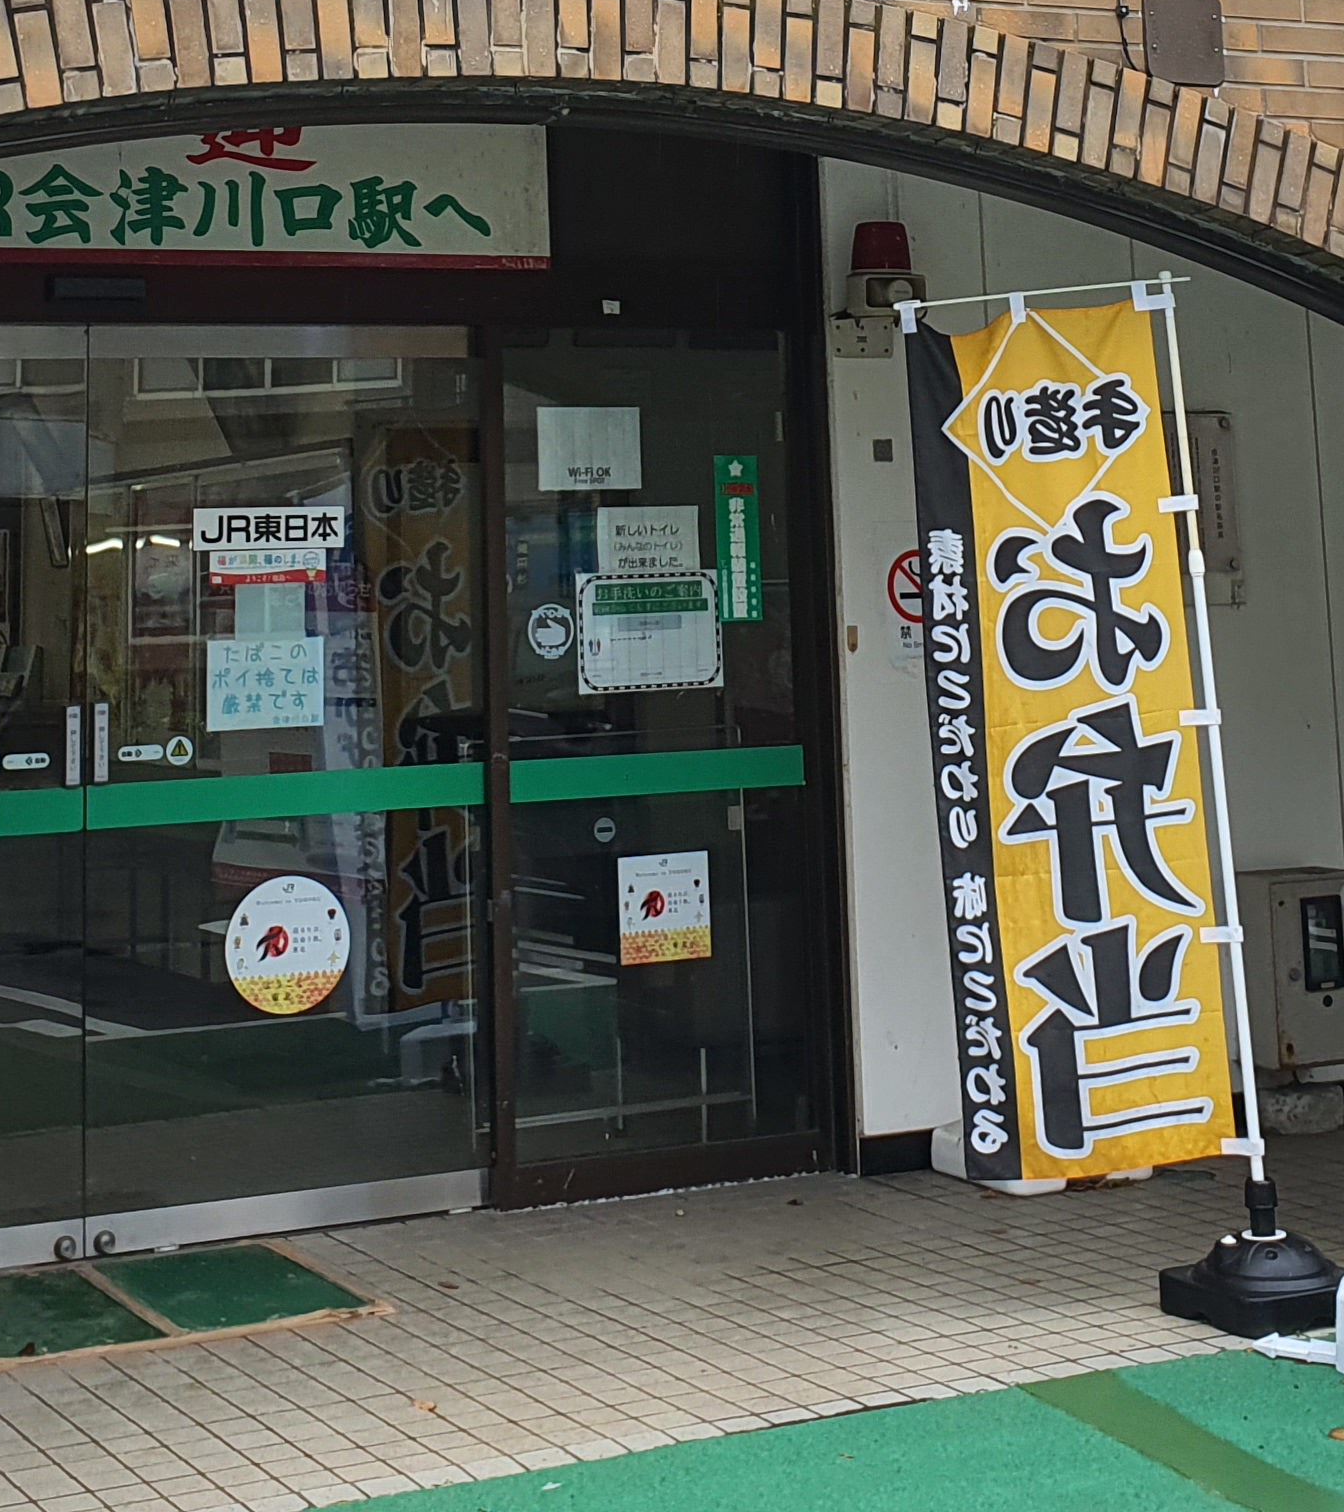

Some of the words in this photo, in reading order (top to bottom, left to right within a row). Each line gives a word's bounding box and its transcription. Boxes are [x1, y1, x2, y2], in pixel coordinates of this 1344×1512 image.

[596, 466, 612, 478] OK
[200, 512, 339, 544] JR東日本
[614, 524, 680, 537] 新しいトイレ
[617, 556, 684, 570] が出来ました。
[223, 642, 308, 664] たばこの
[212, 667, 320, 689] ポイ捨ては
[221, 690, 308, 715] 厳禁です
